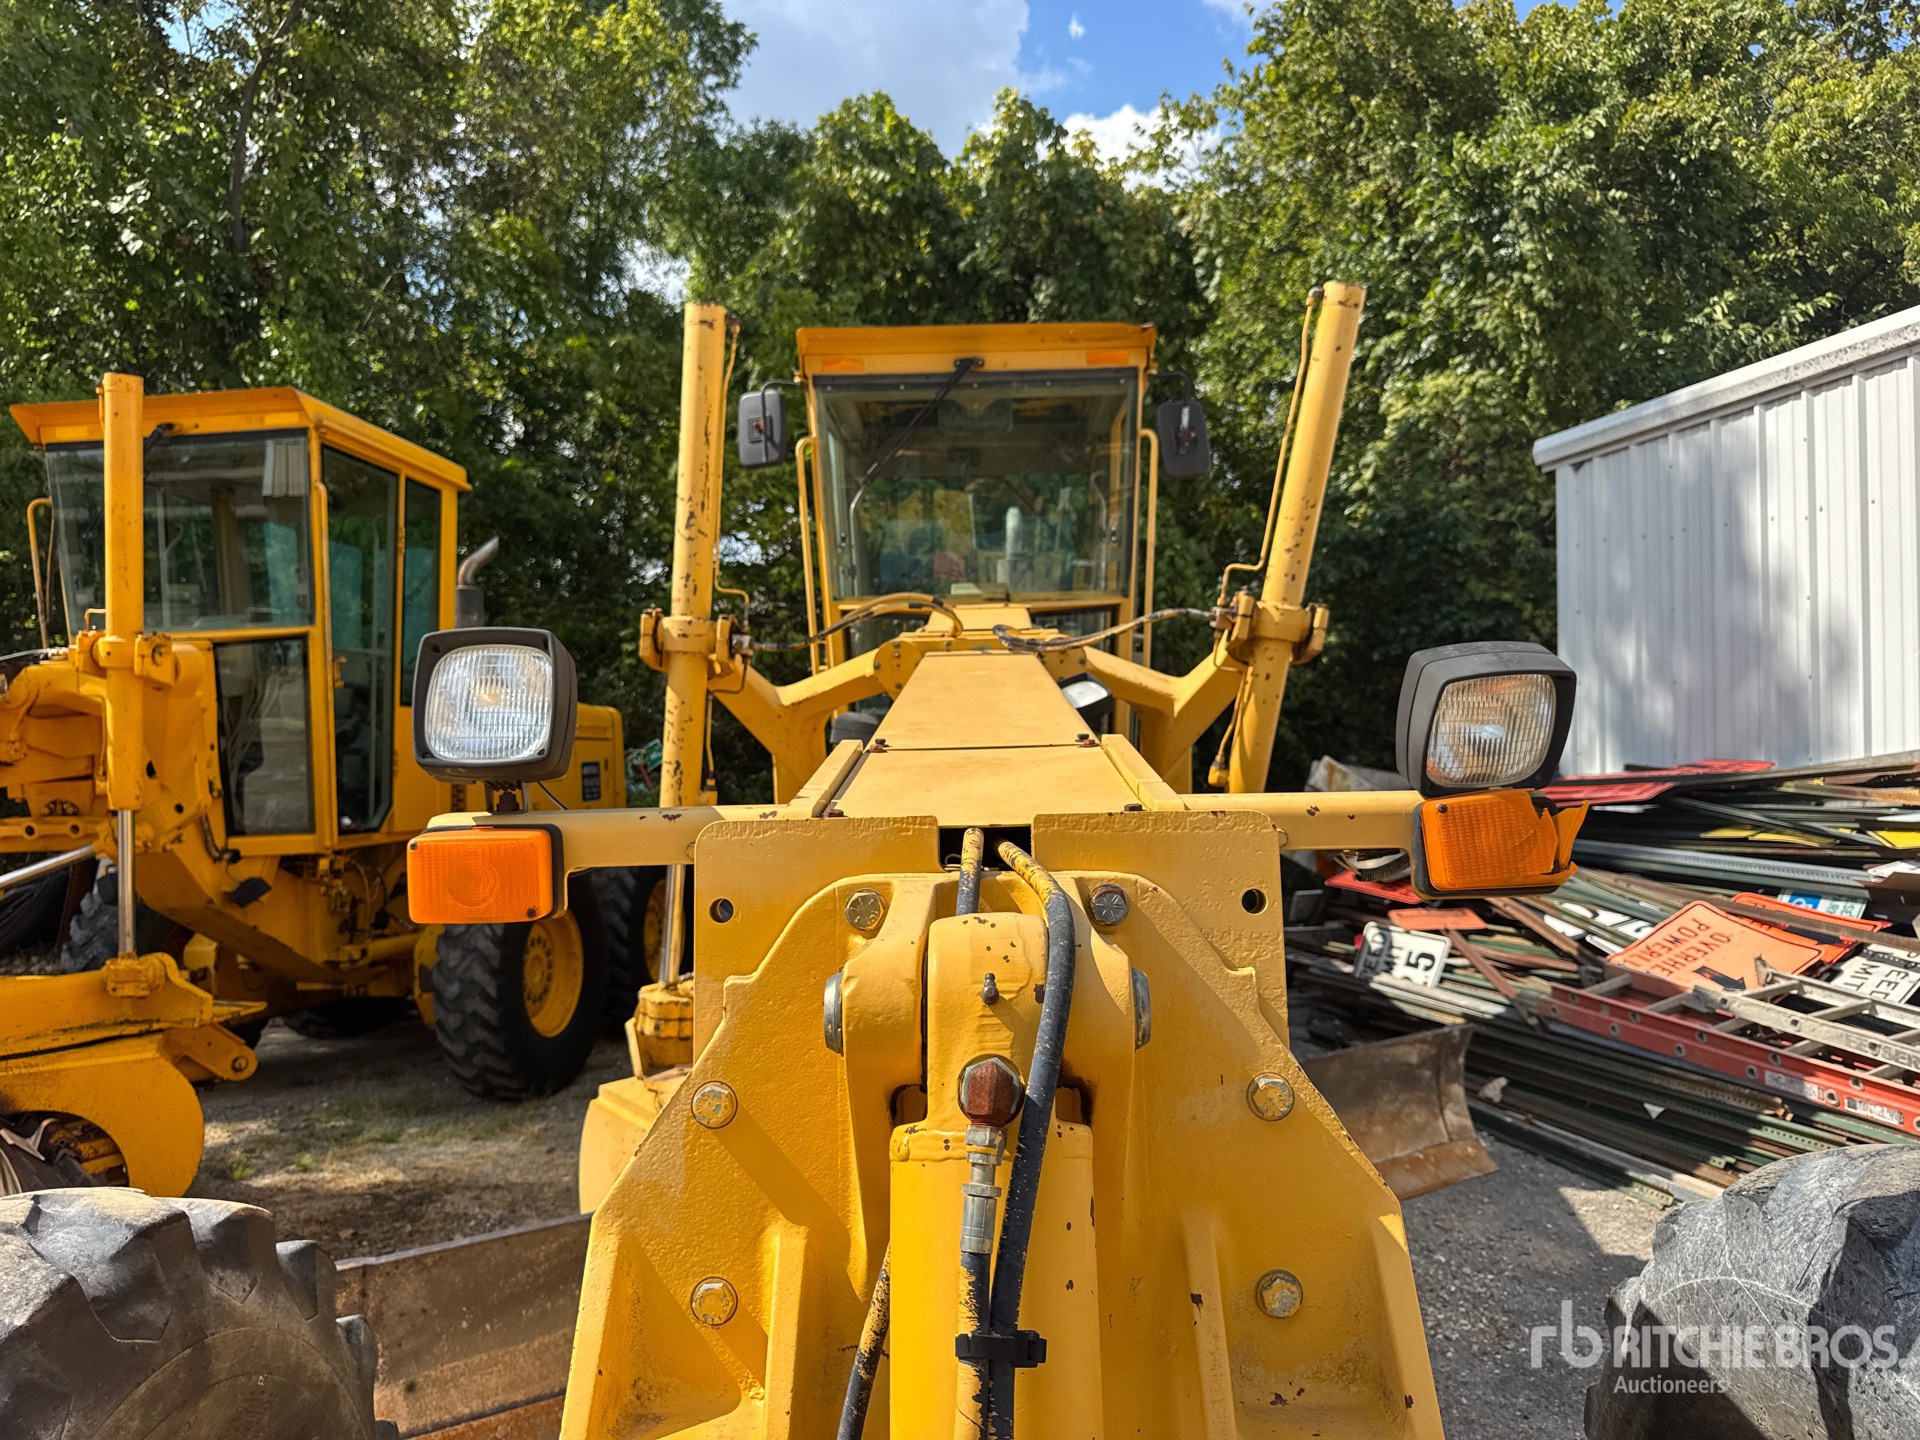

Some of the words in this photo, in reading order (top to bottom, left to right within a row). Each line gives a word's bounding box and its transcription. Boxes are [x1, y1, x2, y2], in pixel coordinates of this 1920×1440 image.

[1383, 940, 1404, 974] MIT
[1402, 950, 1437, 982] 5
[1651, 932, 1732, 977] OVERHE
